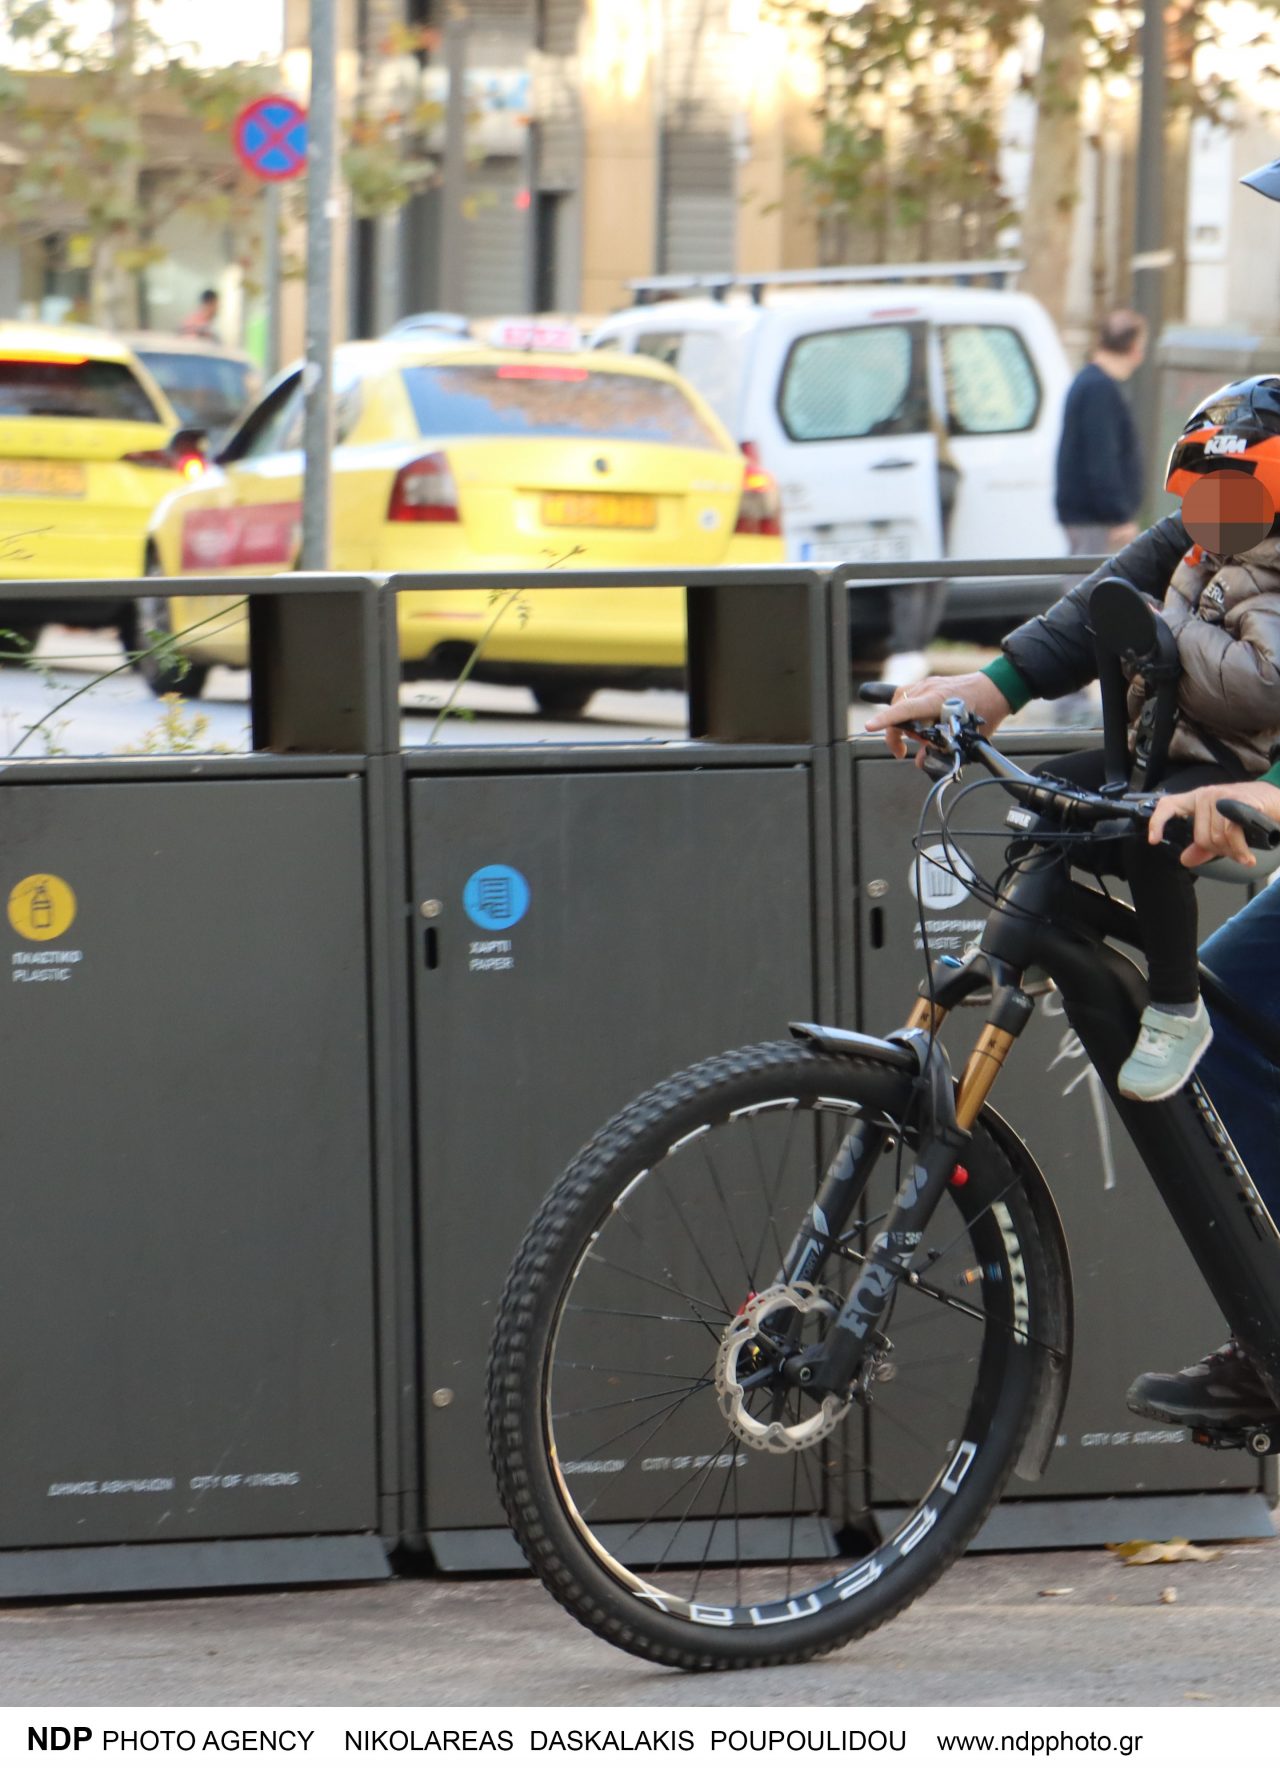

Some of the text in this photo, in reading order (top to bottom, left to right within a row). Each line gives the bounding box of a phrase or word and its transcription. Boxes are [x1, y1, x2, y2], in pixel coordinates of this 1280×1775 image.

[1204, 435, 1247, 455] KTM
[469, 957, 515, 971] PAPER
[12, 967, 72, 982] PLASTIC
[991, 1200, 1030, 1347] MAXXIS
[1081, 1433, 1111, 1447] CITY
[1111, 1432, 1132, 1446] OF
[1132, 1430, 1186, 1446] ATHENS
[641, 1457, 672, 1472] CITY
[672, 1456, 694, 1470] OF
[190, 1471, 300, 1490] CITY OF ATHENS
